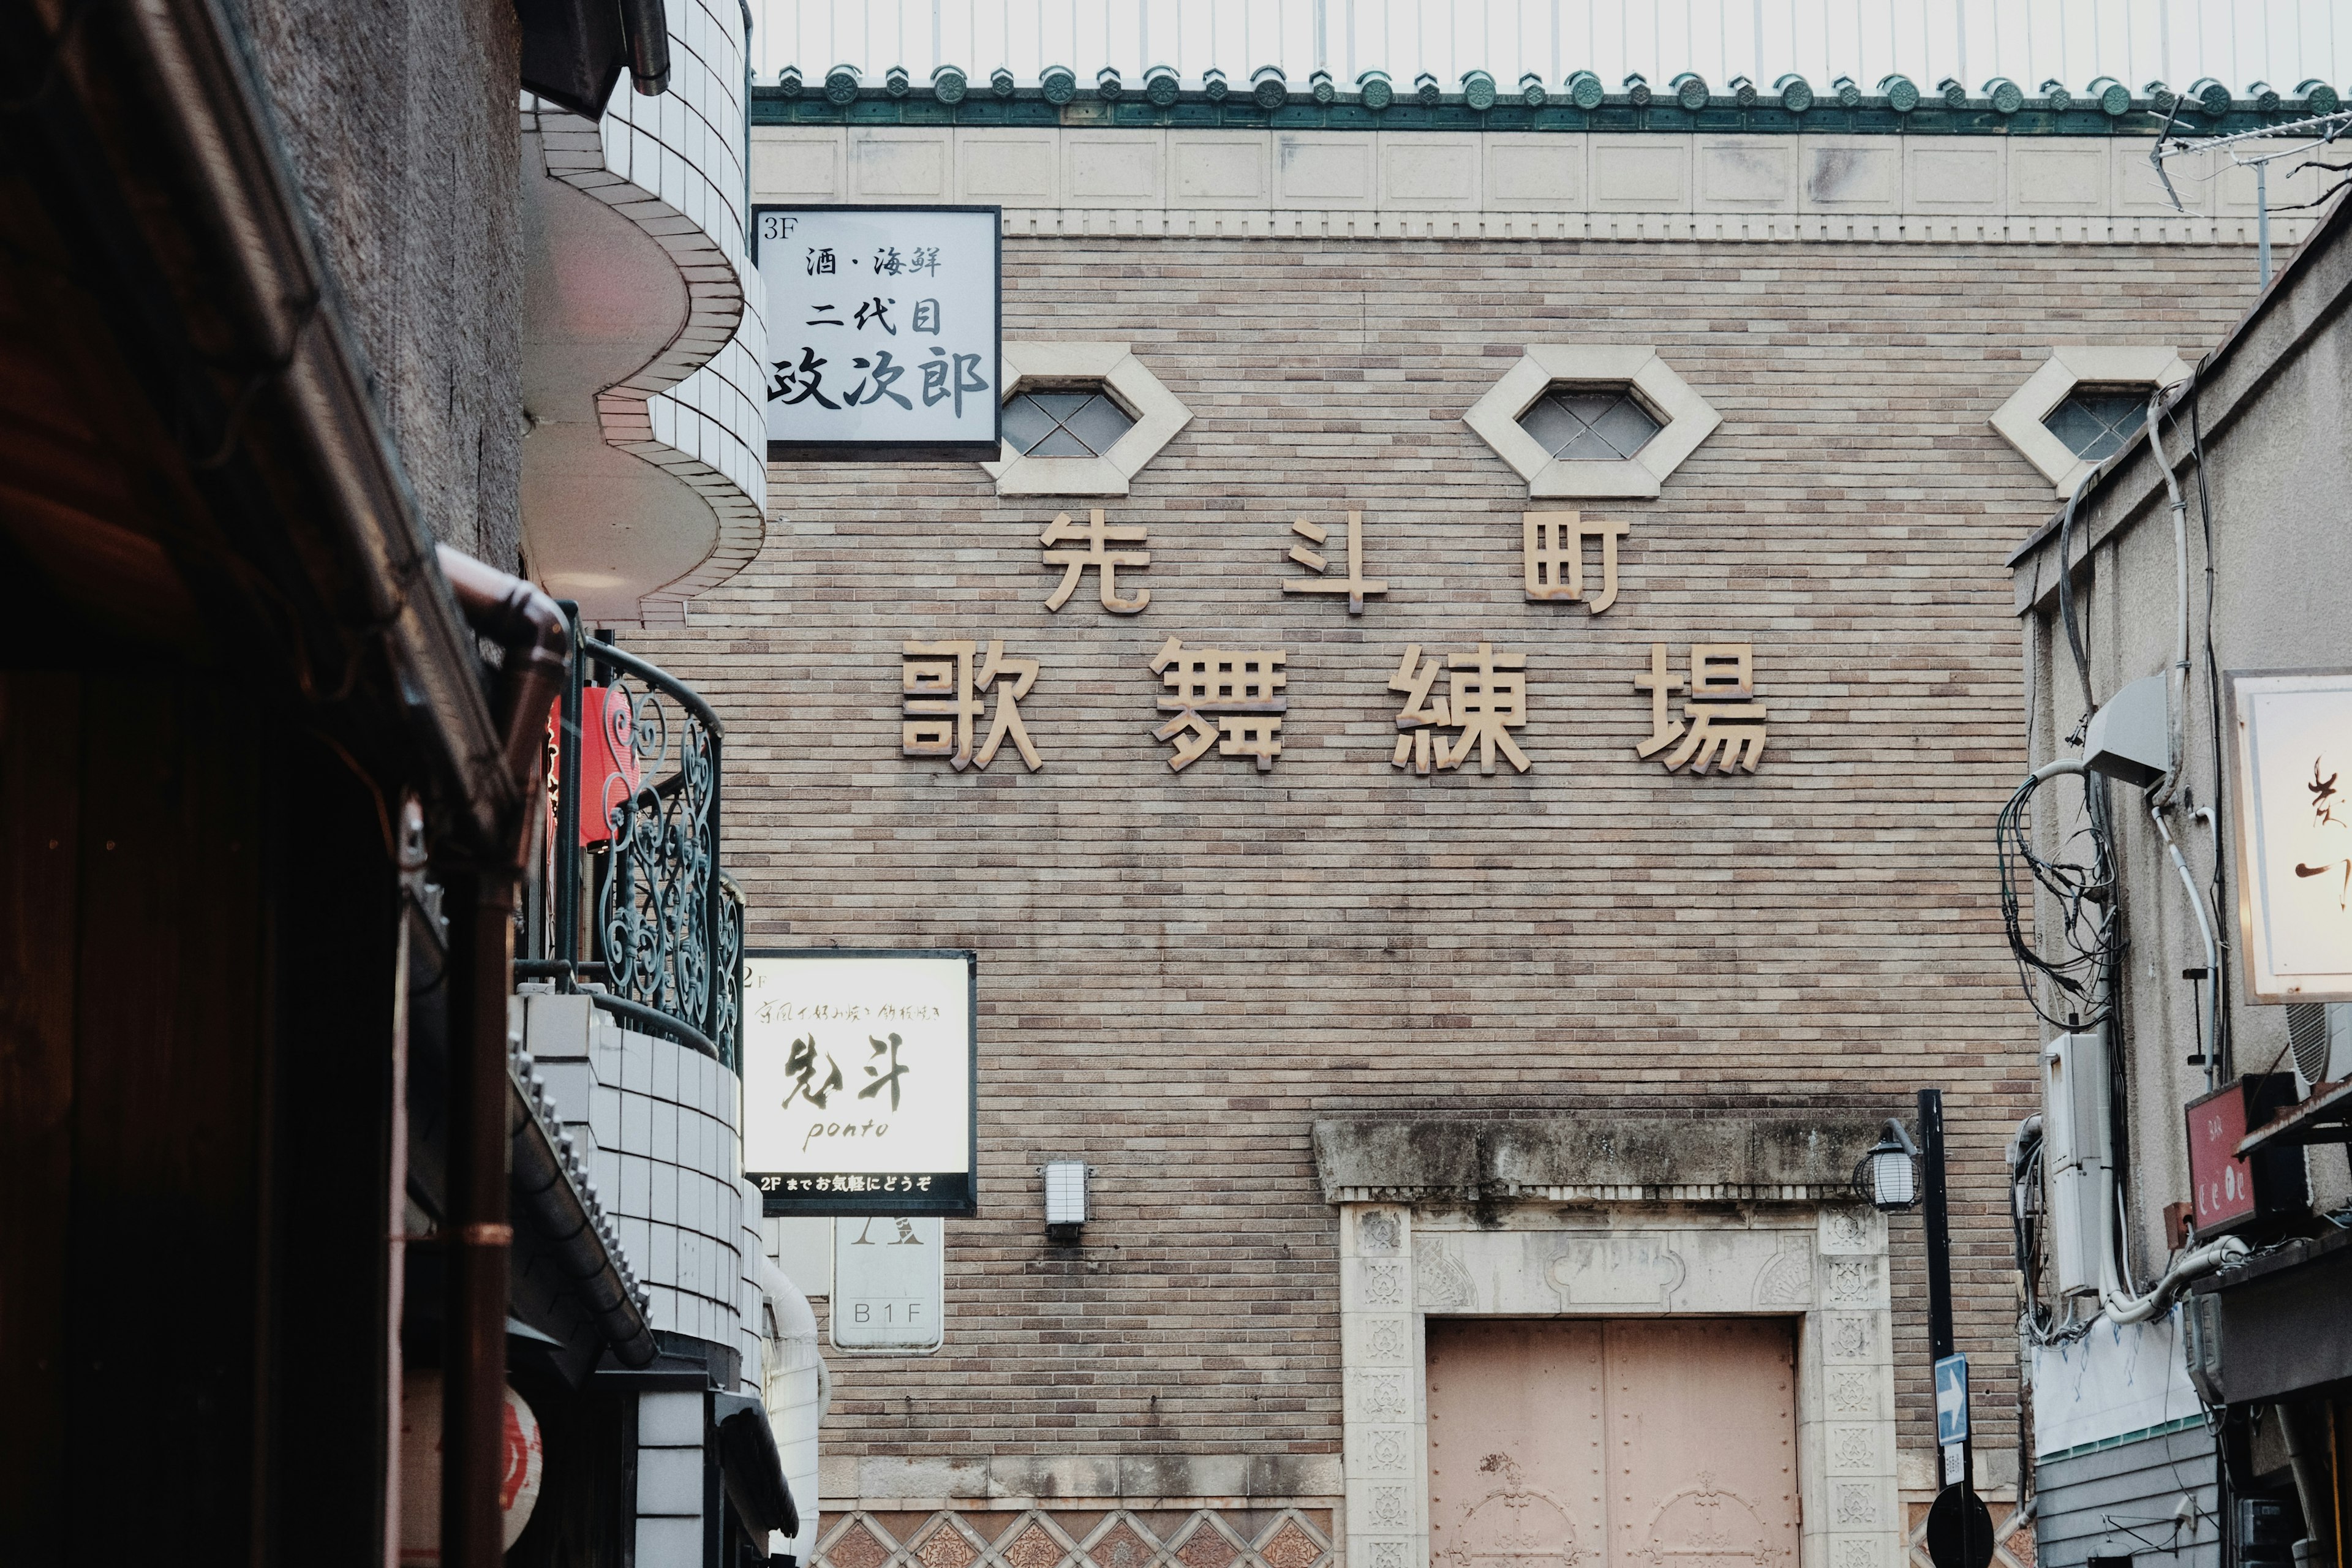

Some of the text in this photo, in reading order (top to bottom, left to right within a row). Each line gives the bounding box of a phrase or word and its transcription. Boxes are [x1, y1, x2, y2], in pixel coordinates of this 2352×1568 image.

[764, 217, 798, 239] 3F
[806, 297, 941, 336] 二代目
[767, 346, 990, 419] 政次郎
[1039, 508, 1630, 614] 先斗町
[902, 636, 1768, 776] 歌舞練場
[802, 1118, 889, 1154] ponto
